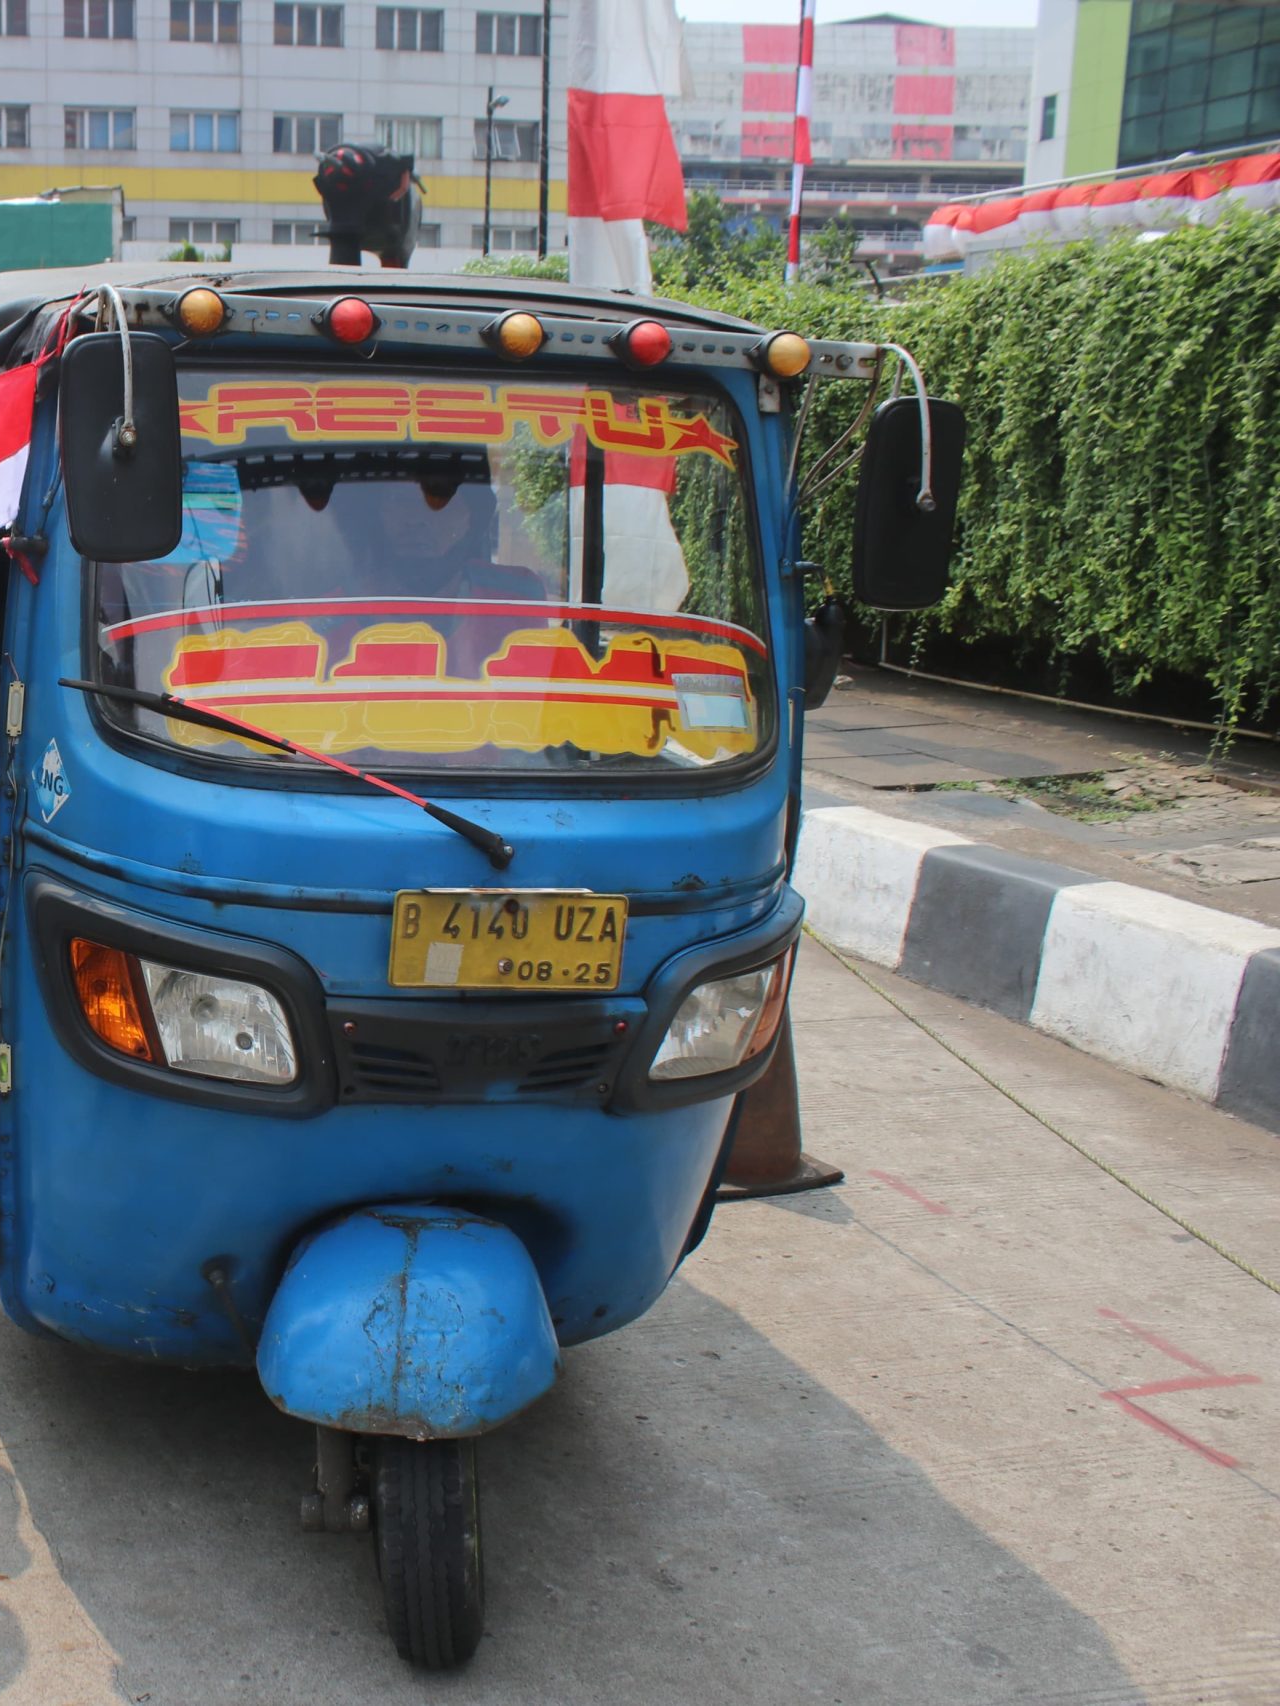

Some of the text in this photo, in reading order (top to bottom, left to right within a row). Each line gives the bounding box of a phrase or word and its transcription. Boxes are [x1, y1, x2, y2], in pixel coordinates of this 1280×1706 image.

[212, 383, 674, 453] RESTU
[401, 902, 618, 943] B 4140 UZA
